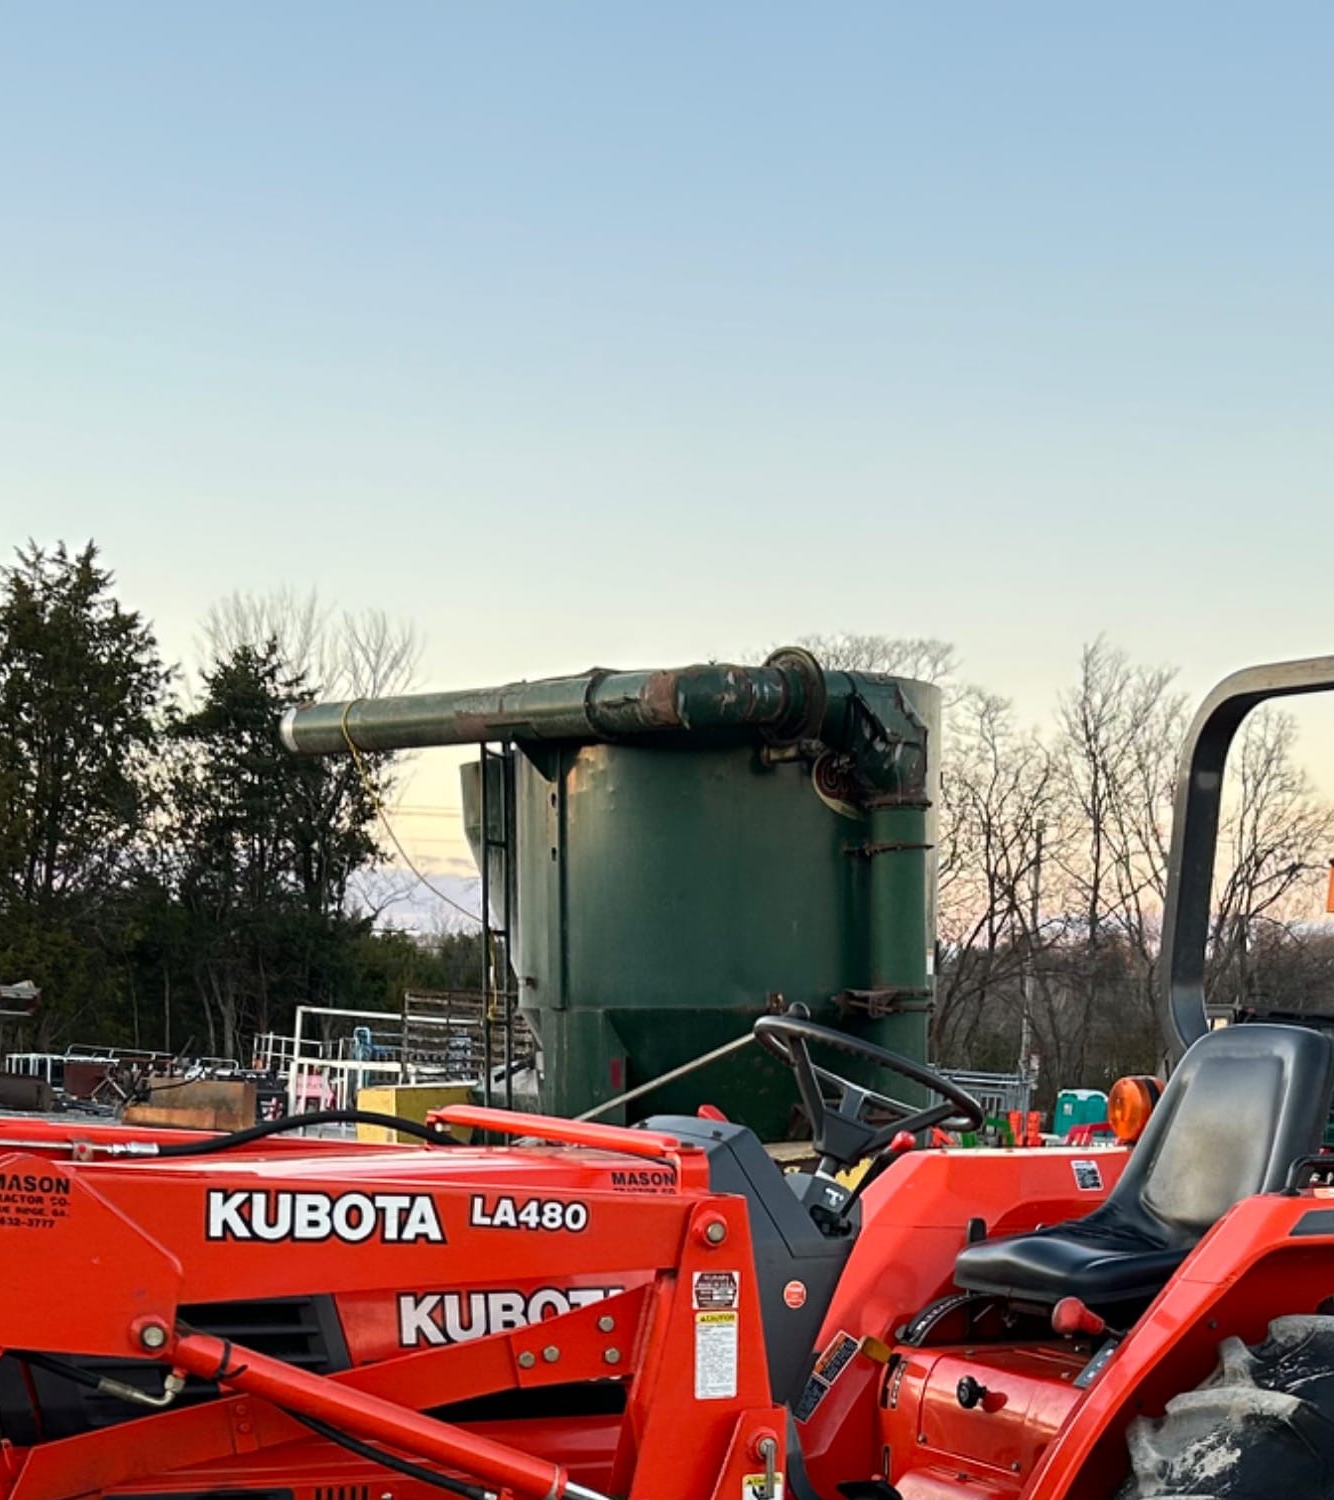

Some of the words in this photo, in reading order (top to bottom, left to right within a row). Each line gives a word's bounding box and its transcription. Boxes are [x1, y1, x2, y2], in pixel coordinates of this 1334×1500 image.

[611, 1172, 676, 1186] MASON
[208, 1190, 444, 1242] KUBOTA
[471, 1196, 588, 1233] LA480
[399, 1288, 624, 1346] KUBOT
